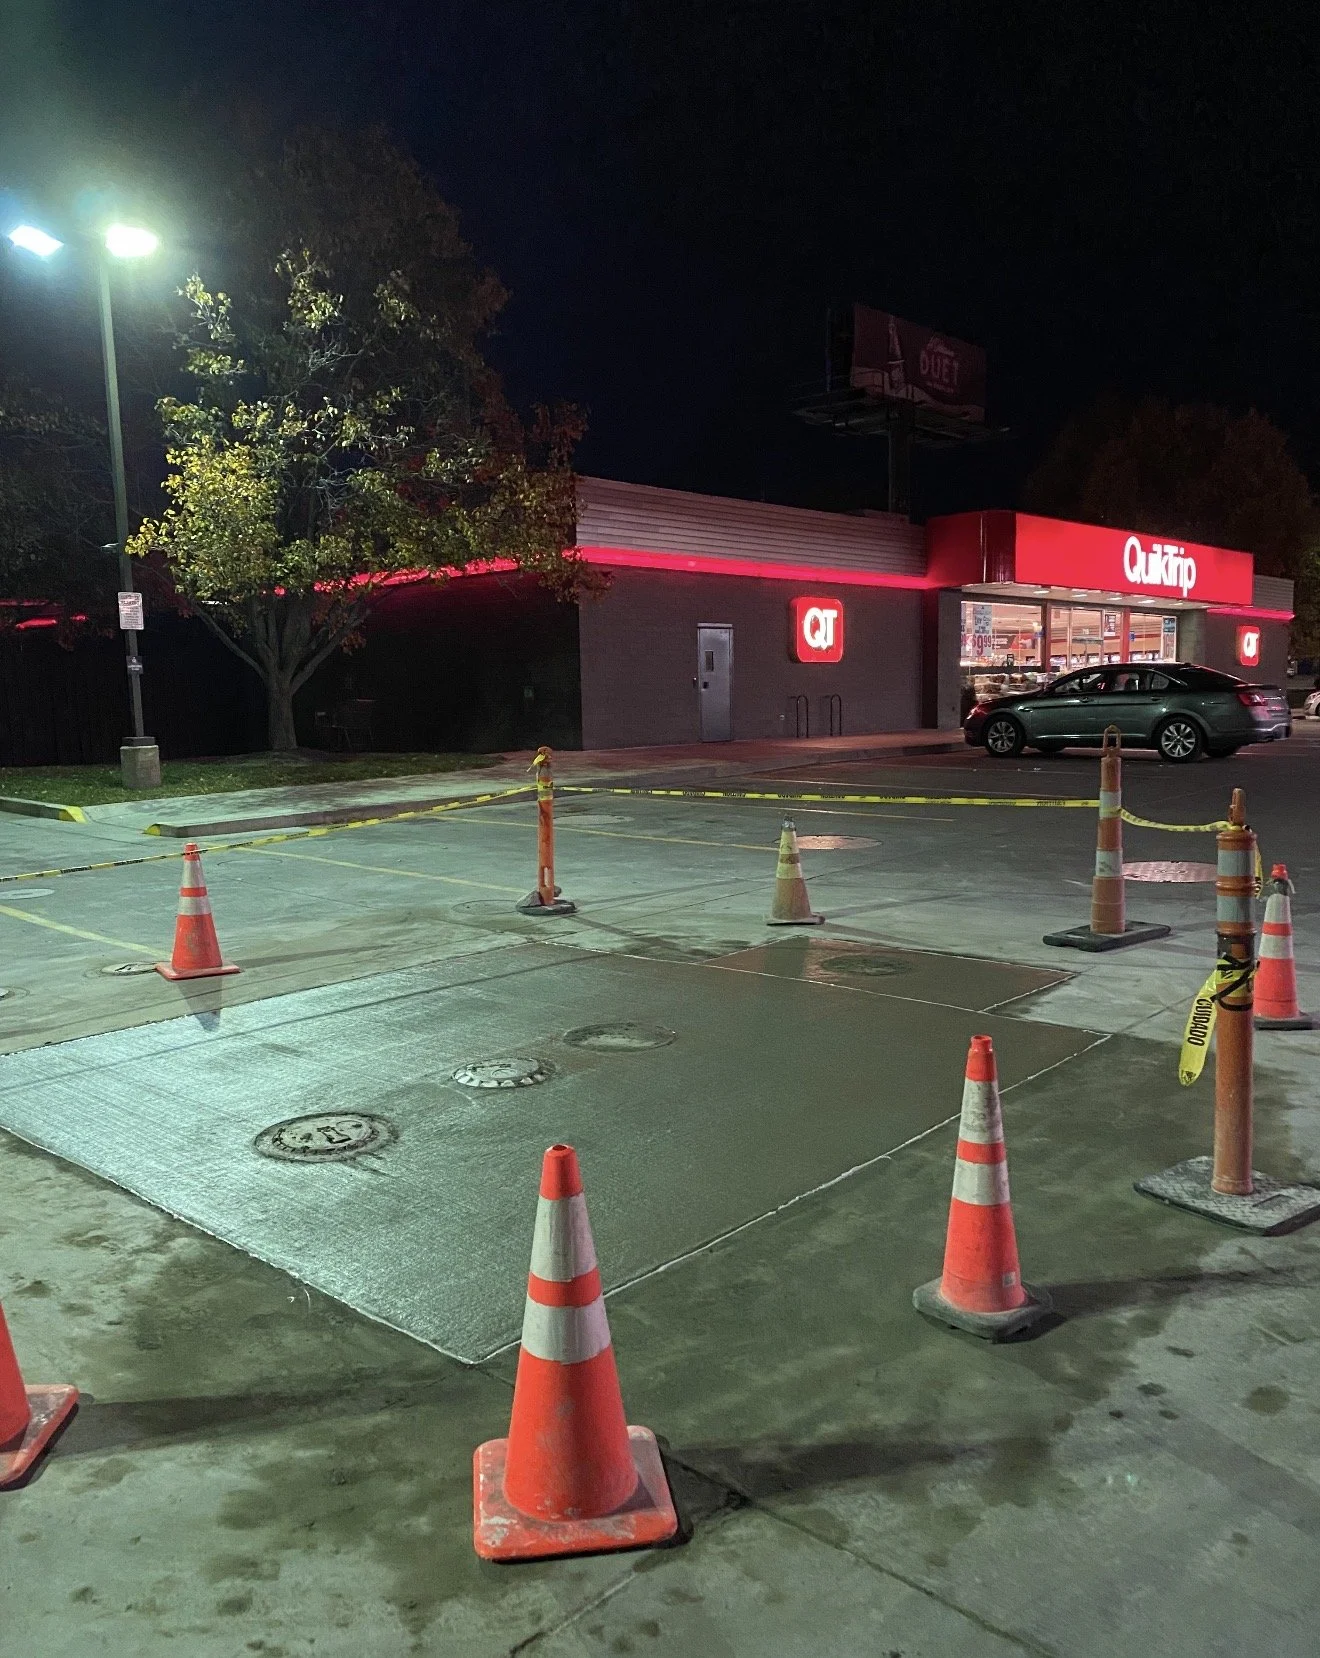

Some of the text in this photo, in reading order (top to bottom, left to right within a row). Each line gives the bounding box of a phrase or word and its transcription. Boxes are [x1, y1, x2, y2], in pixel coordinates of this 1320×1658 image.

[1123, 535, 1197, 598] QuikTrip
[803, 606, 838, 651] QT
[1243, 631, 1259, 658] QT
[1187, 998, 1213, 1047] CUIDADO
